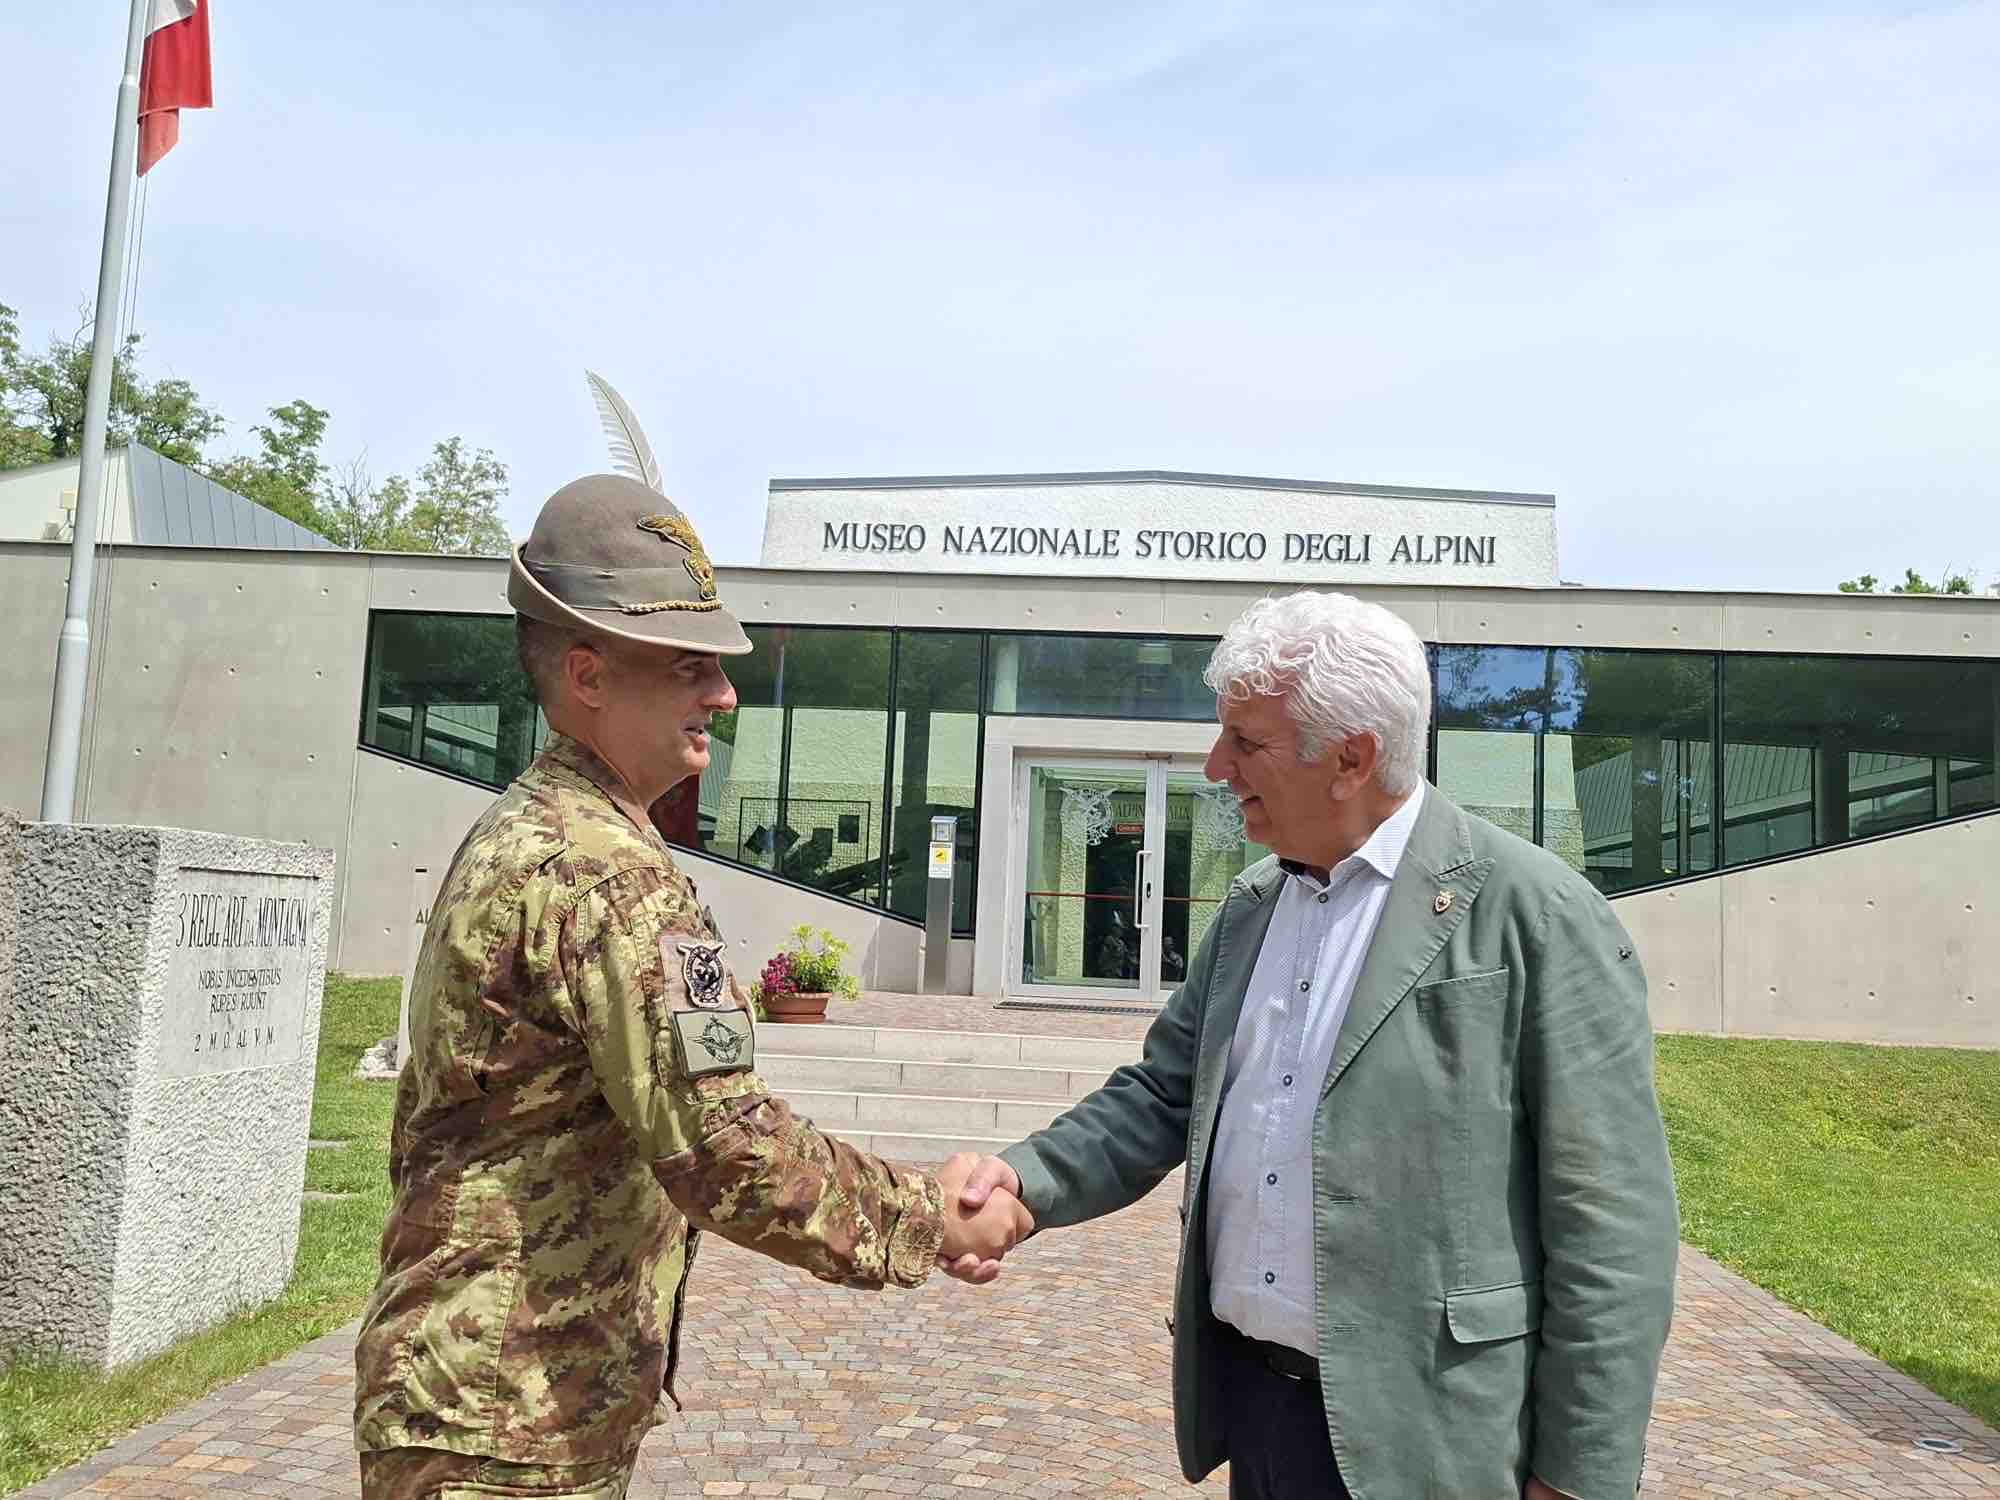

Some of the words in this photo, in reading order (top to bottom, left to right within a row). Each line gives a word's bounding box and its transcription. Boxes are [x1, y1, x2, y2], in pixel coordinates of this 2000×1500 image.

[824, 522, 926, 550] MUSEO
[943, 526, 1121, 556] NAZIONALE
[1135, 530, 1267, 560] STORICO
[1283, 533, 1372, 562] DEGLI
[1389, 535, 1496, 564] ALPINI
[256, 896, 308, 947] MONTAGNA
